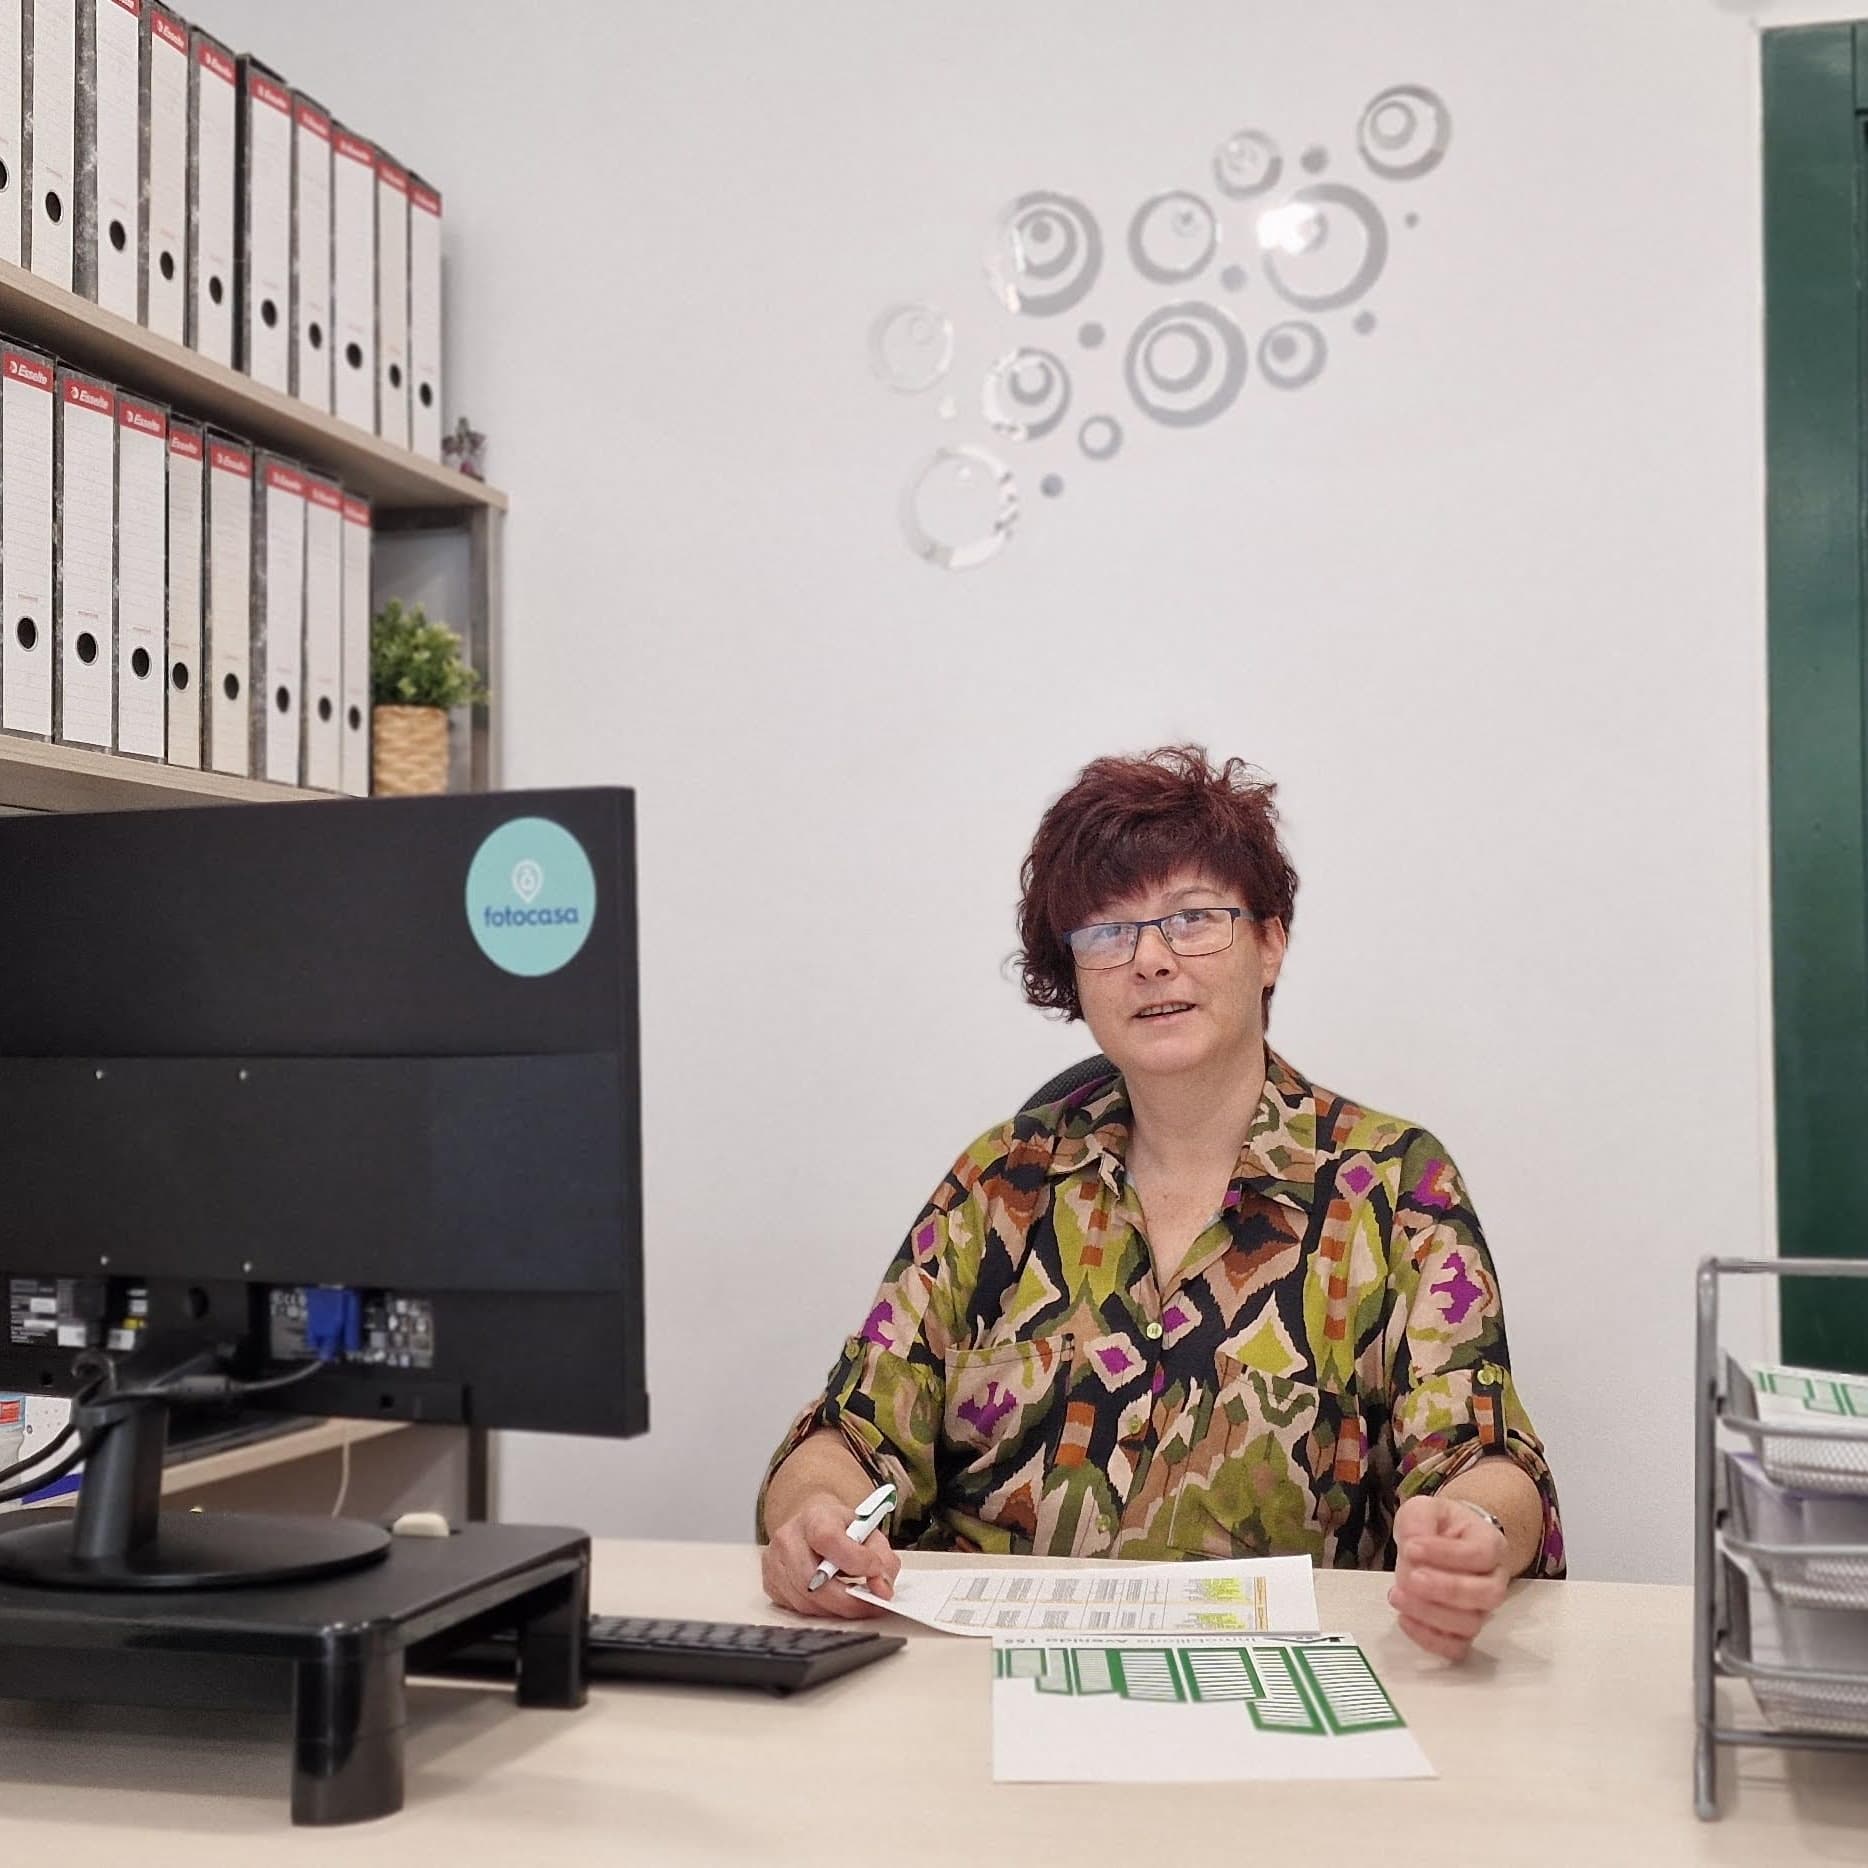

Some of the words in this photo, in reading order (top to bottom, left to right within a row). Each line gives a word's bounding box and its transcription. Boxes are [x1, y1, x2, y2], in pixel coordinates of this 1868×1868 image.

[18, 364, 48, 385] Esselte
[79, 390, 109, 410] Esselte
[484, 906, 579, 927] fotocasa
